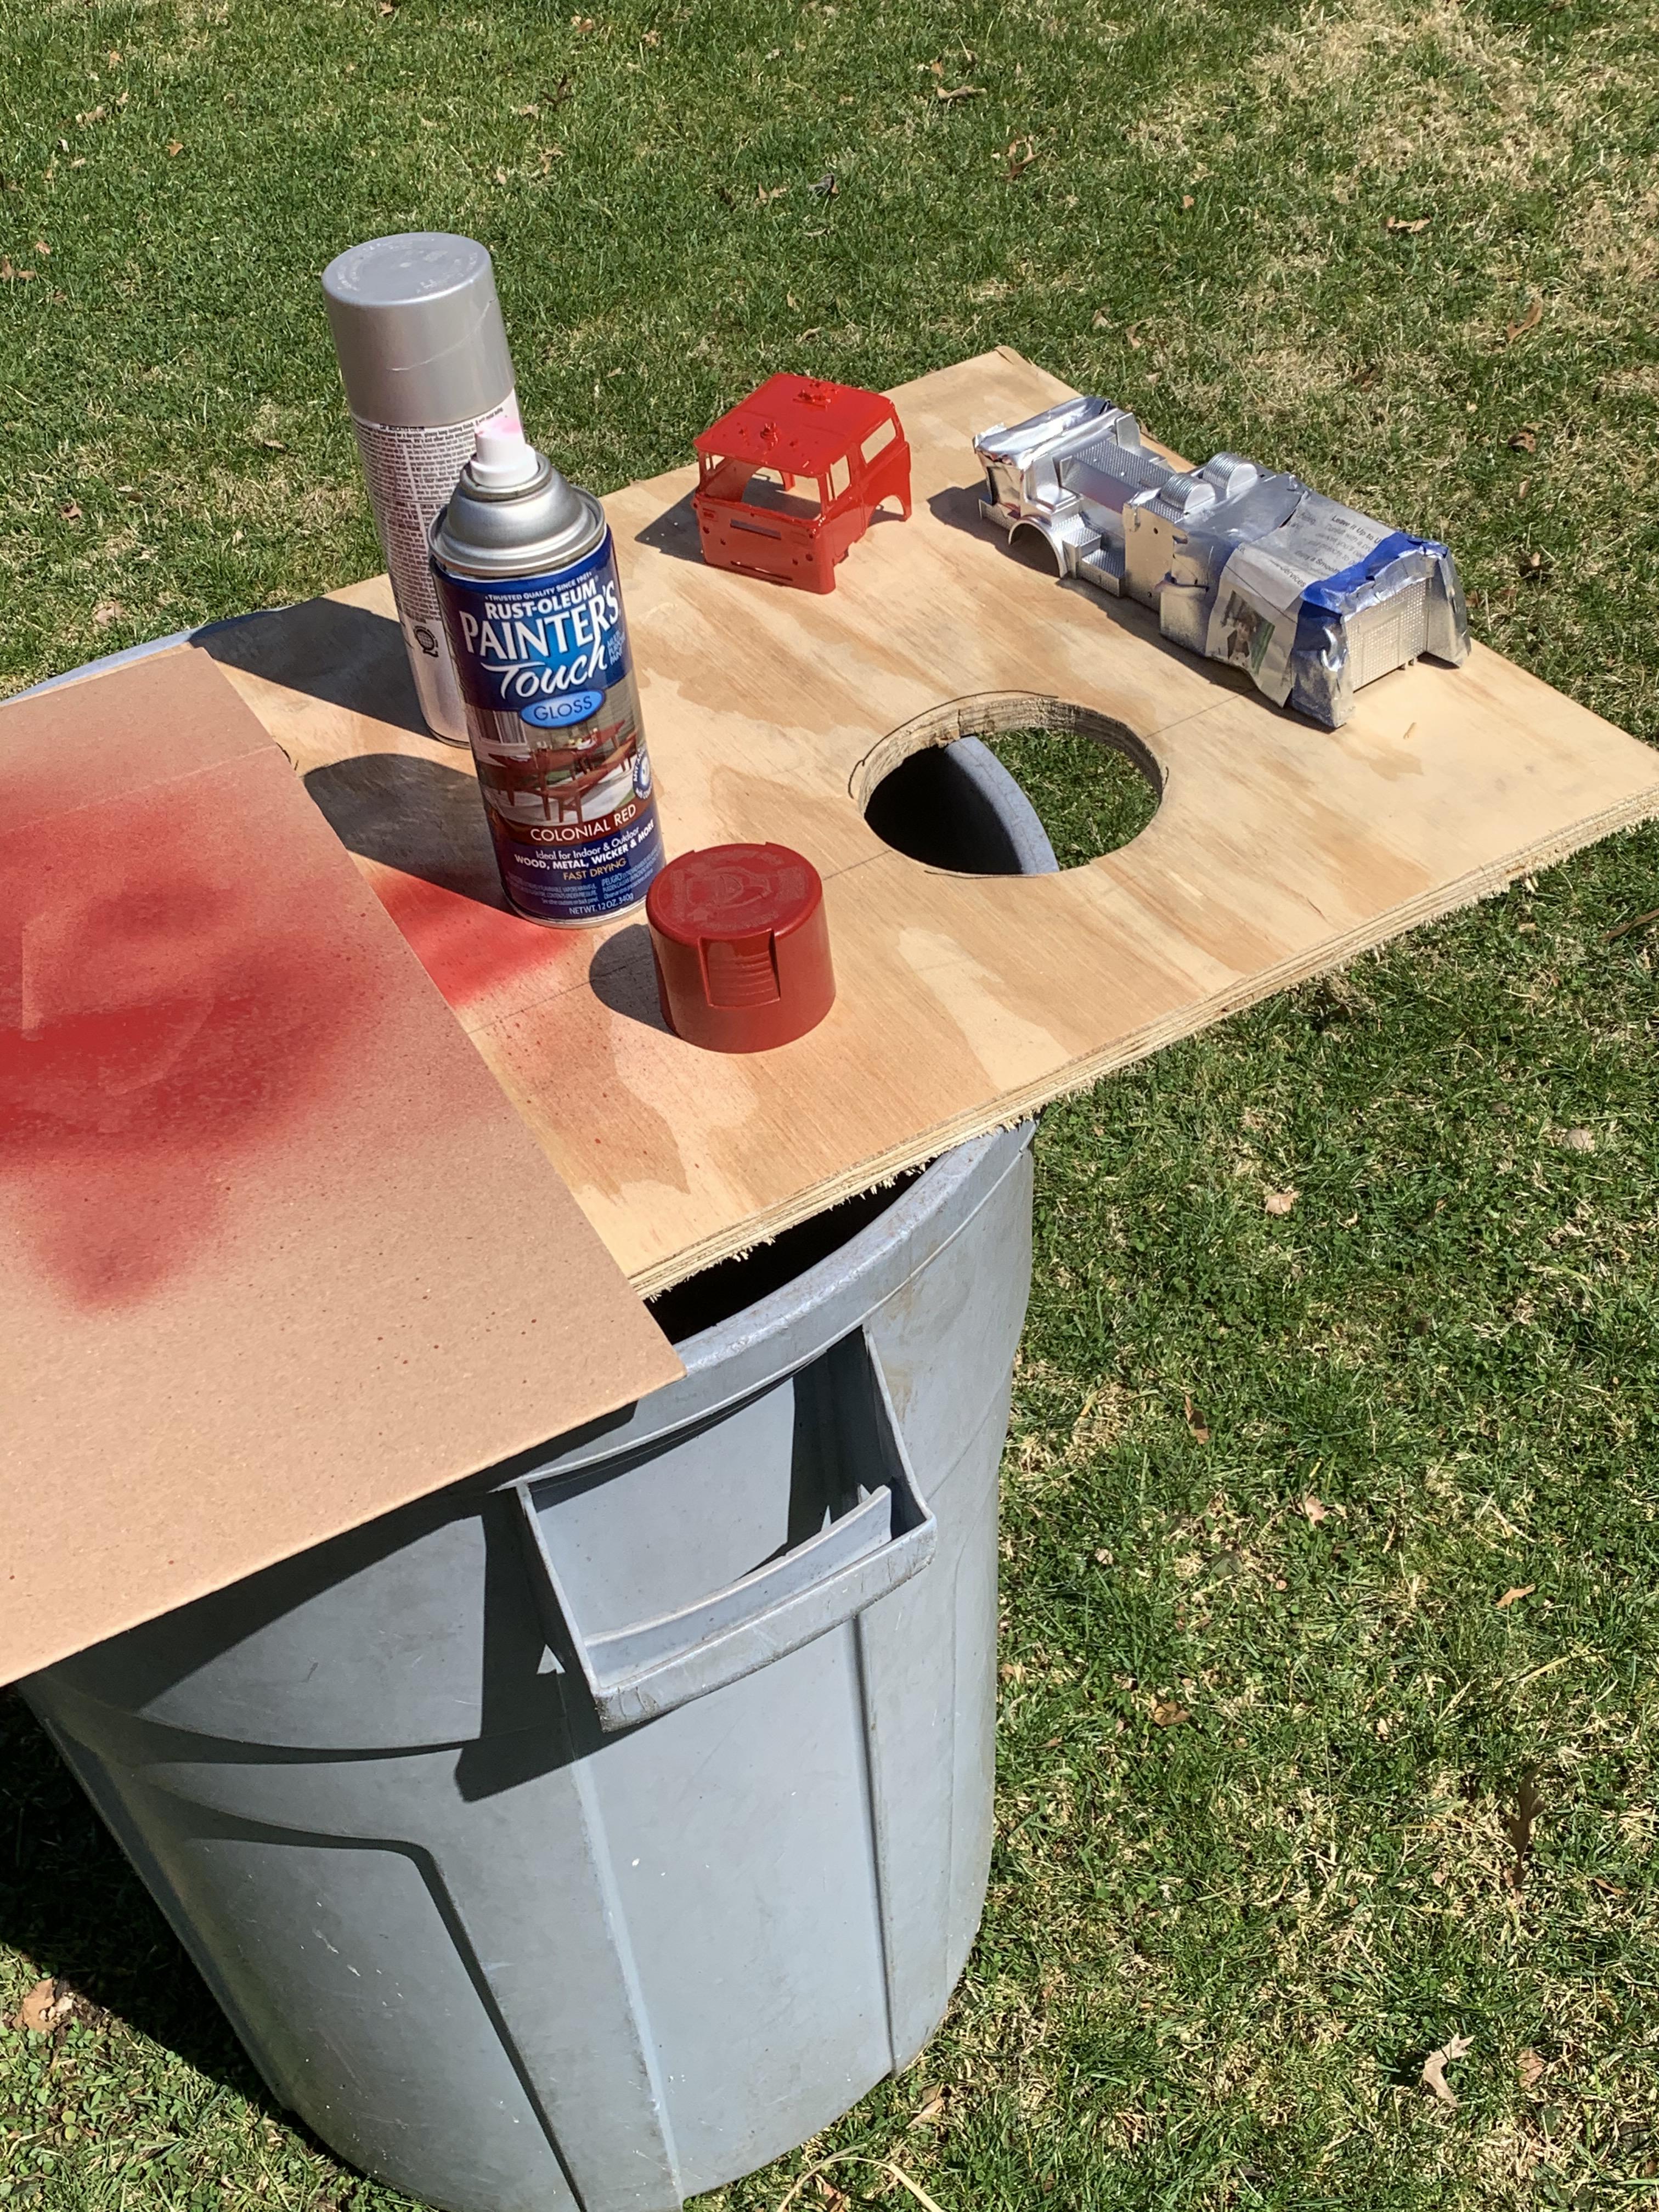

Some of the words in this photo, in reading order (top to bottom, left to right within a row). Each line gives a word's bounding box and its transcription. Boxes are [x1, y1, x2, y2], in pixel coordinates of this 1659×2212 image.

[1331, 515, 1351, 527] Leave
[1356, 527, 1366, 536] Up
[1366, 533, 1374, 541] to
[484, 578, 596, 620] RUST-OLEUM
[523, 587, 555, 600] QUALITY
[556, 580, 575, 591] SINCE
[459, 580, 619, 660] PAINTER'S
[481, 636, 607, 699] Touch
[533, 696, 592, 721] GLOSS
[531, 820, 611, 842] COLONIAL
[614, 804, 636, 827] RED
[515, 854, 550, 870] WOOD,
[552, 860, 589, 870] METAL,
[591, 844, 629, 865] WICKER
[630, 840, 637, 849] &
[637, 819, 654, 843] MORE
[535, 850, 557, 860] Ideal
[558, 850, 571, 860] for
[573, 847, 601, 858] Indoor
[603, 842, 610, 851] &
[611, 827, 640, 848] Outdoor
[563, 870, 586, 881] FAST
[590, 857, 627, 877] DRYING
[619, 893, 634, 905] 340g
